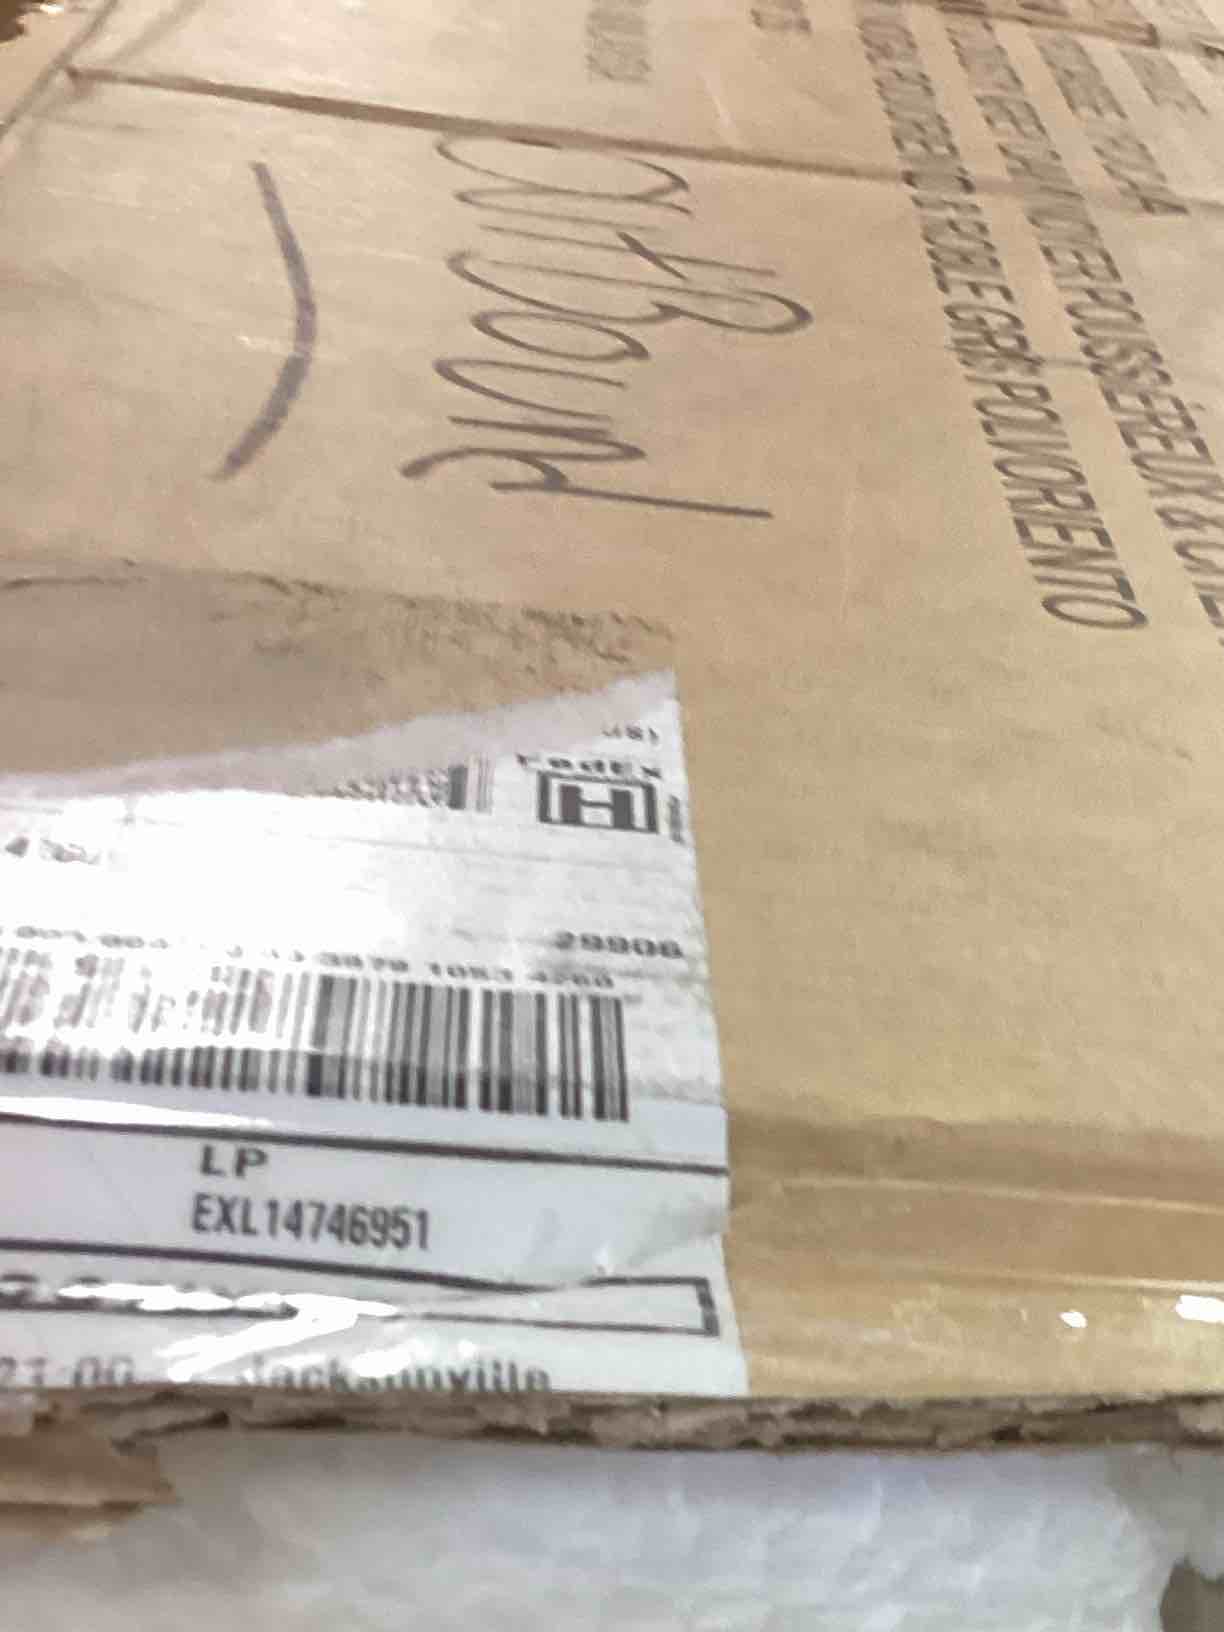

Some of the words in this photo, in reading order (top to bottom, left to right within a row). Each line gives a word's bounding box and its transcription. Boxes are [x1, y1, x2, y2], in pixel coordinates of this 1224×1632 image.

[962, 375, 1147, 628] POLVORIENTO
[201, 1144, 269, 1179] LP
[190, 1191, 431, 1252] EXL14746951
